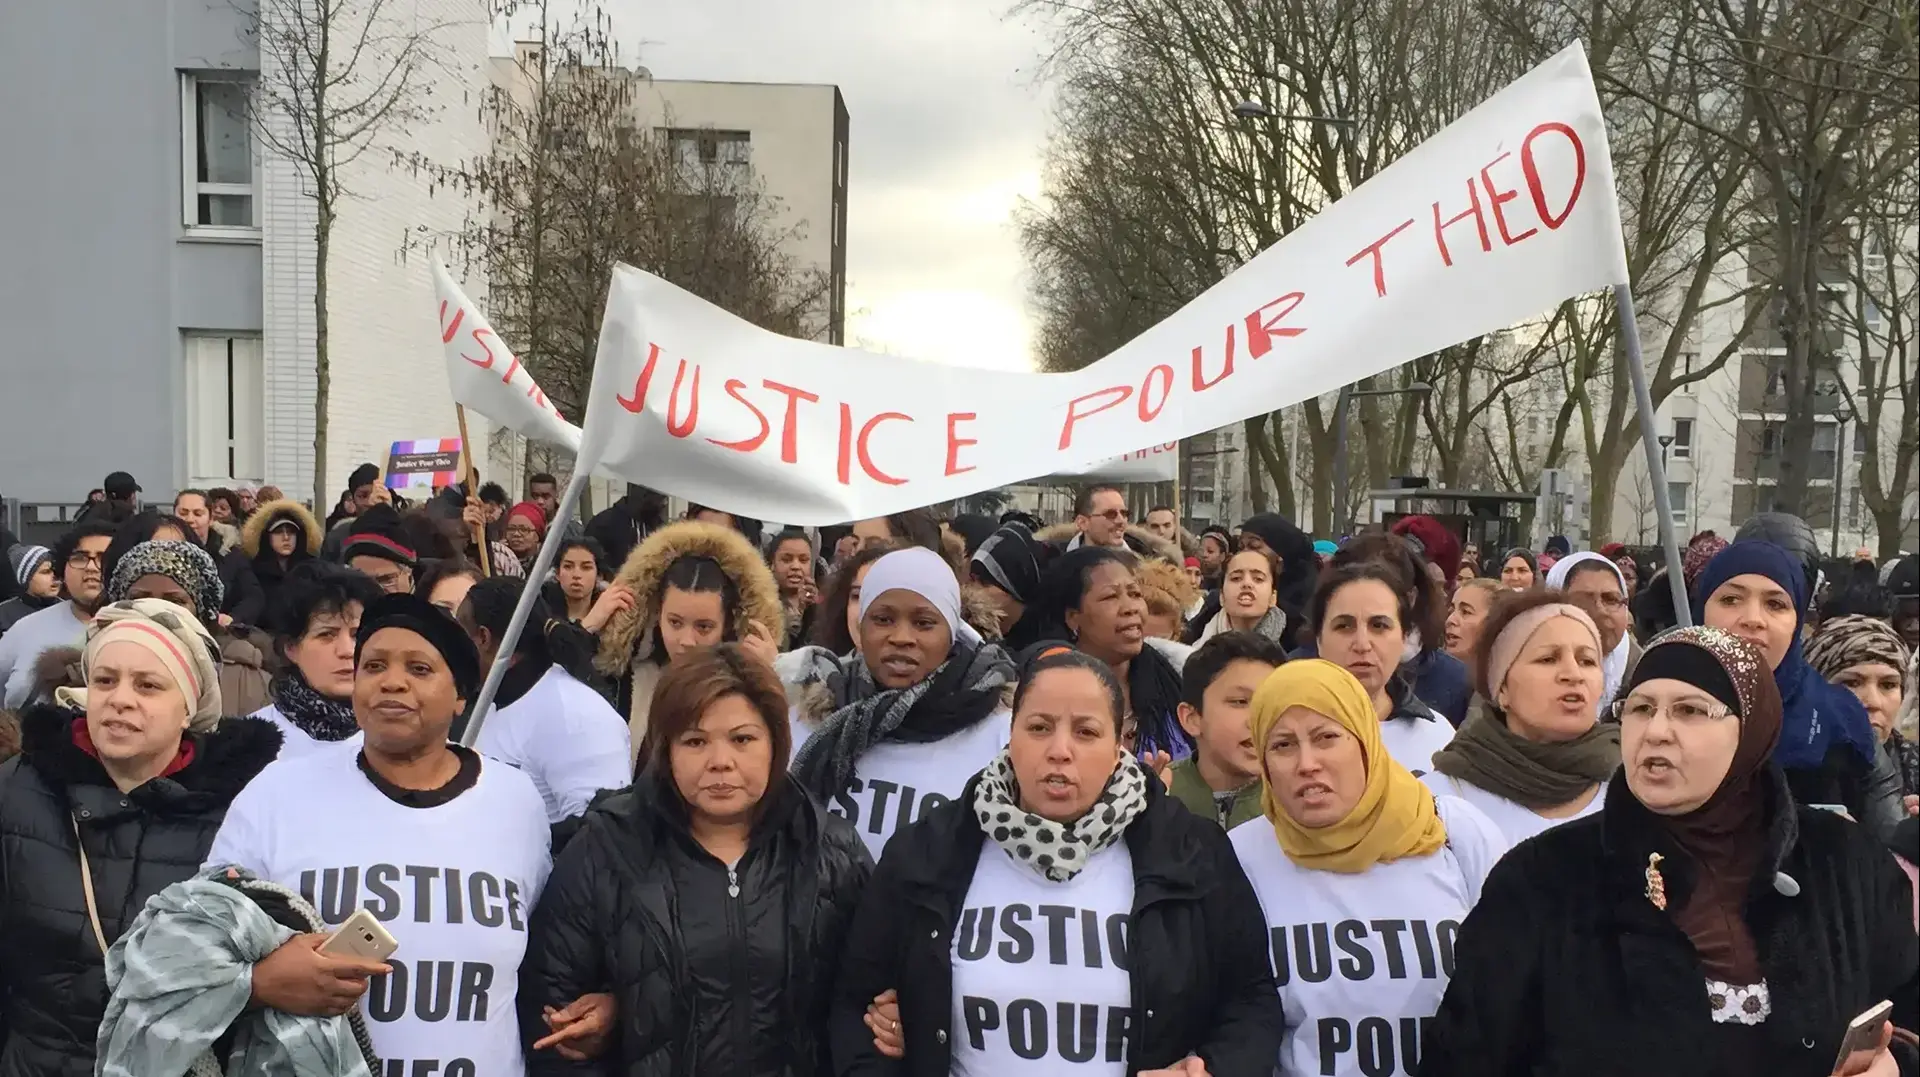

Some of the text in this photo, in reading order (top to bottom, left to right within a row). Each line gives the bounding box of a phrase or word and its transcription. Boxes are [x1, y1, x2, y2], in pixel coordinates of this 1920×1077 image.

[616, 341, 978, 486] JUSTICE
[1058, 291, 1308, 451] POUR
[368, 958, 495, 1022] OUR
[1317, 1017, 1437, 1077] POU
